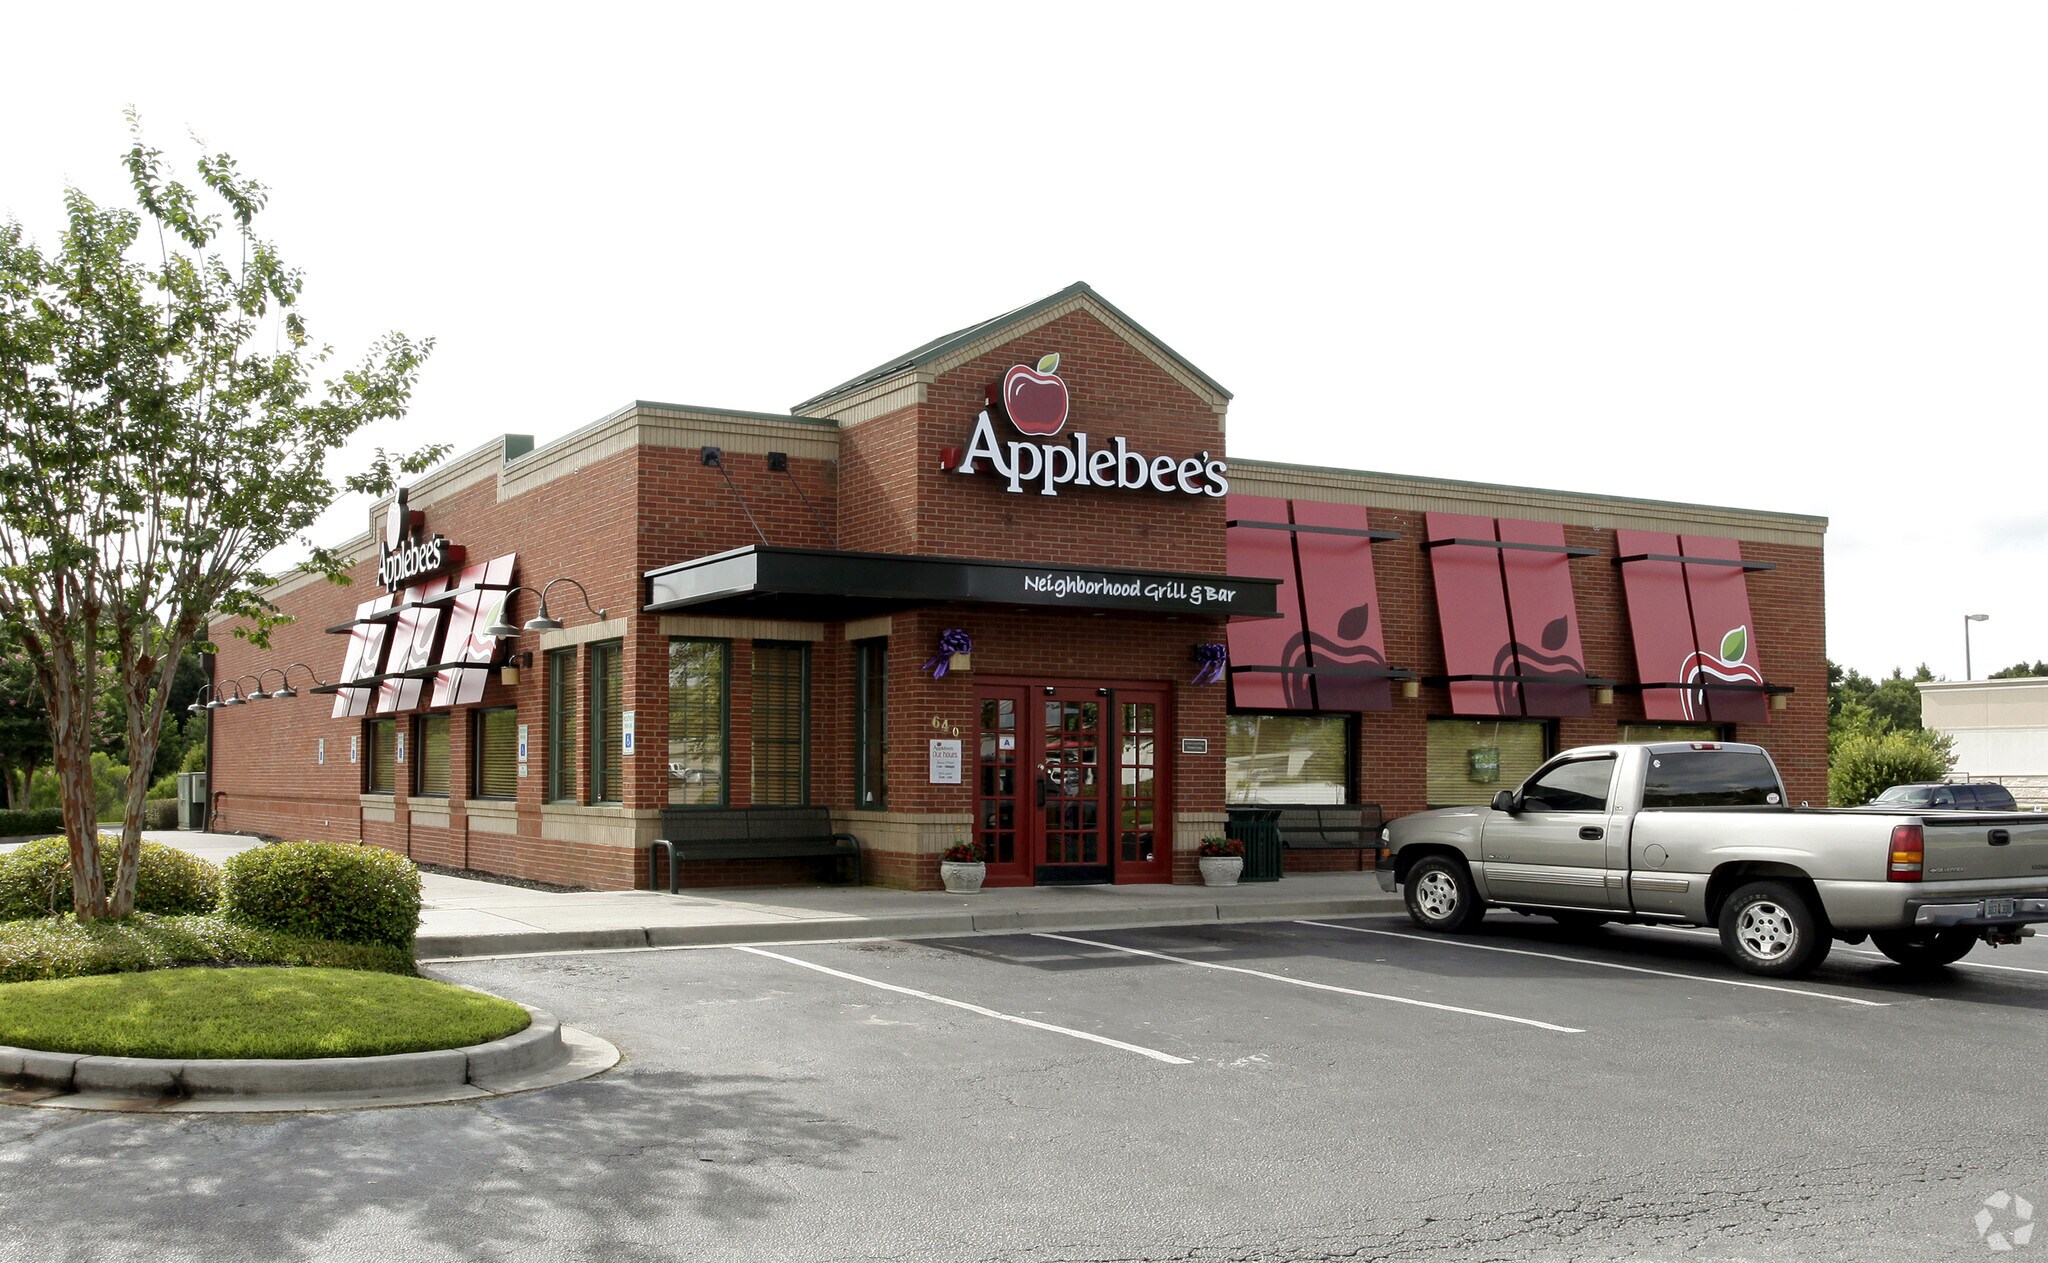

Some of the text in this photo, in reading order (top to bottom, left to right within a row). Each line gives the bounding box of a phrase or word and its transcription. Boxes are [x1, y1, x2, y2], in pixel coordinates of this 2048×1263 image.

[959, 410, 1229, 497] Applebee's
[376, 533, 441, 593] Applebee's
[1024, 574, 1236, 604] Neighborhood Grill & Bar
[932, 716, 959, 737] 640
